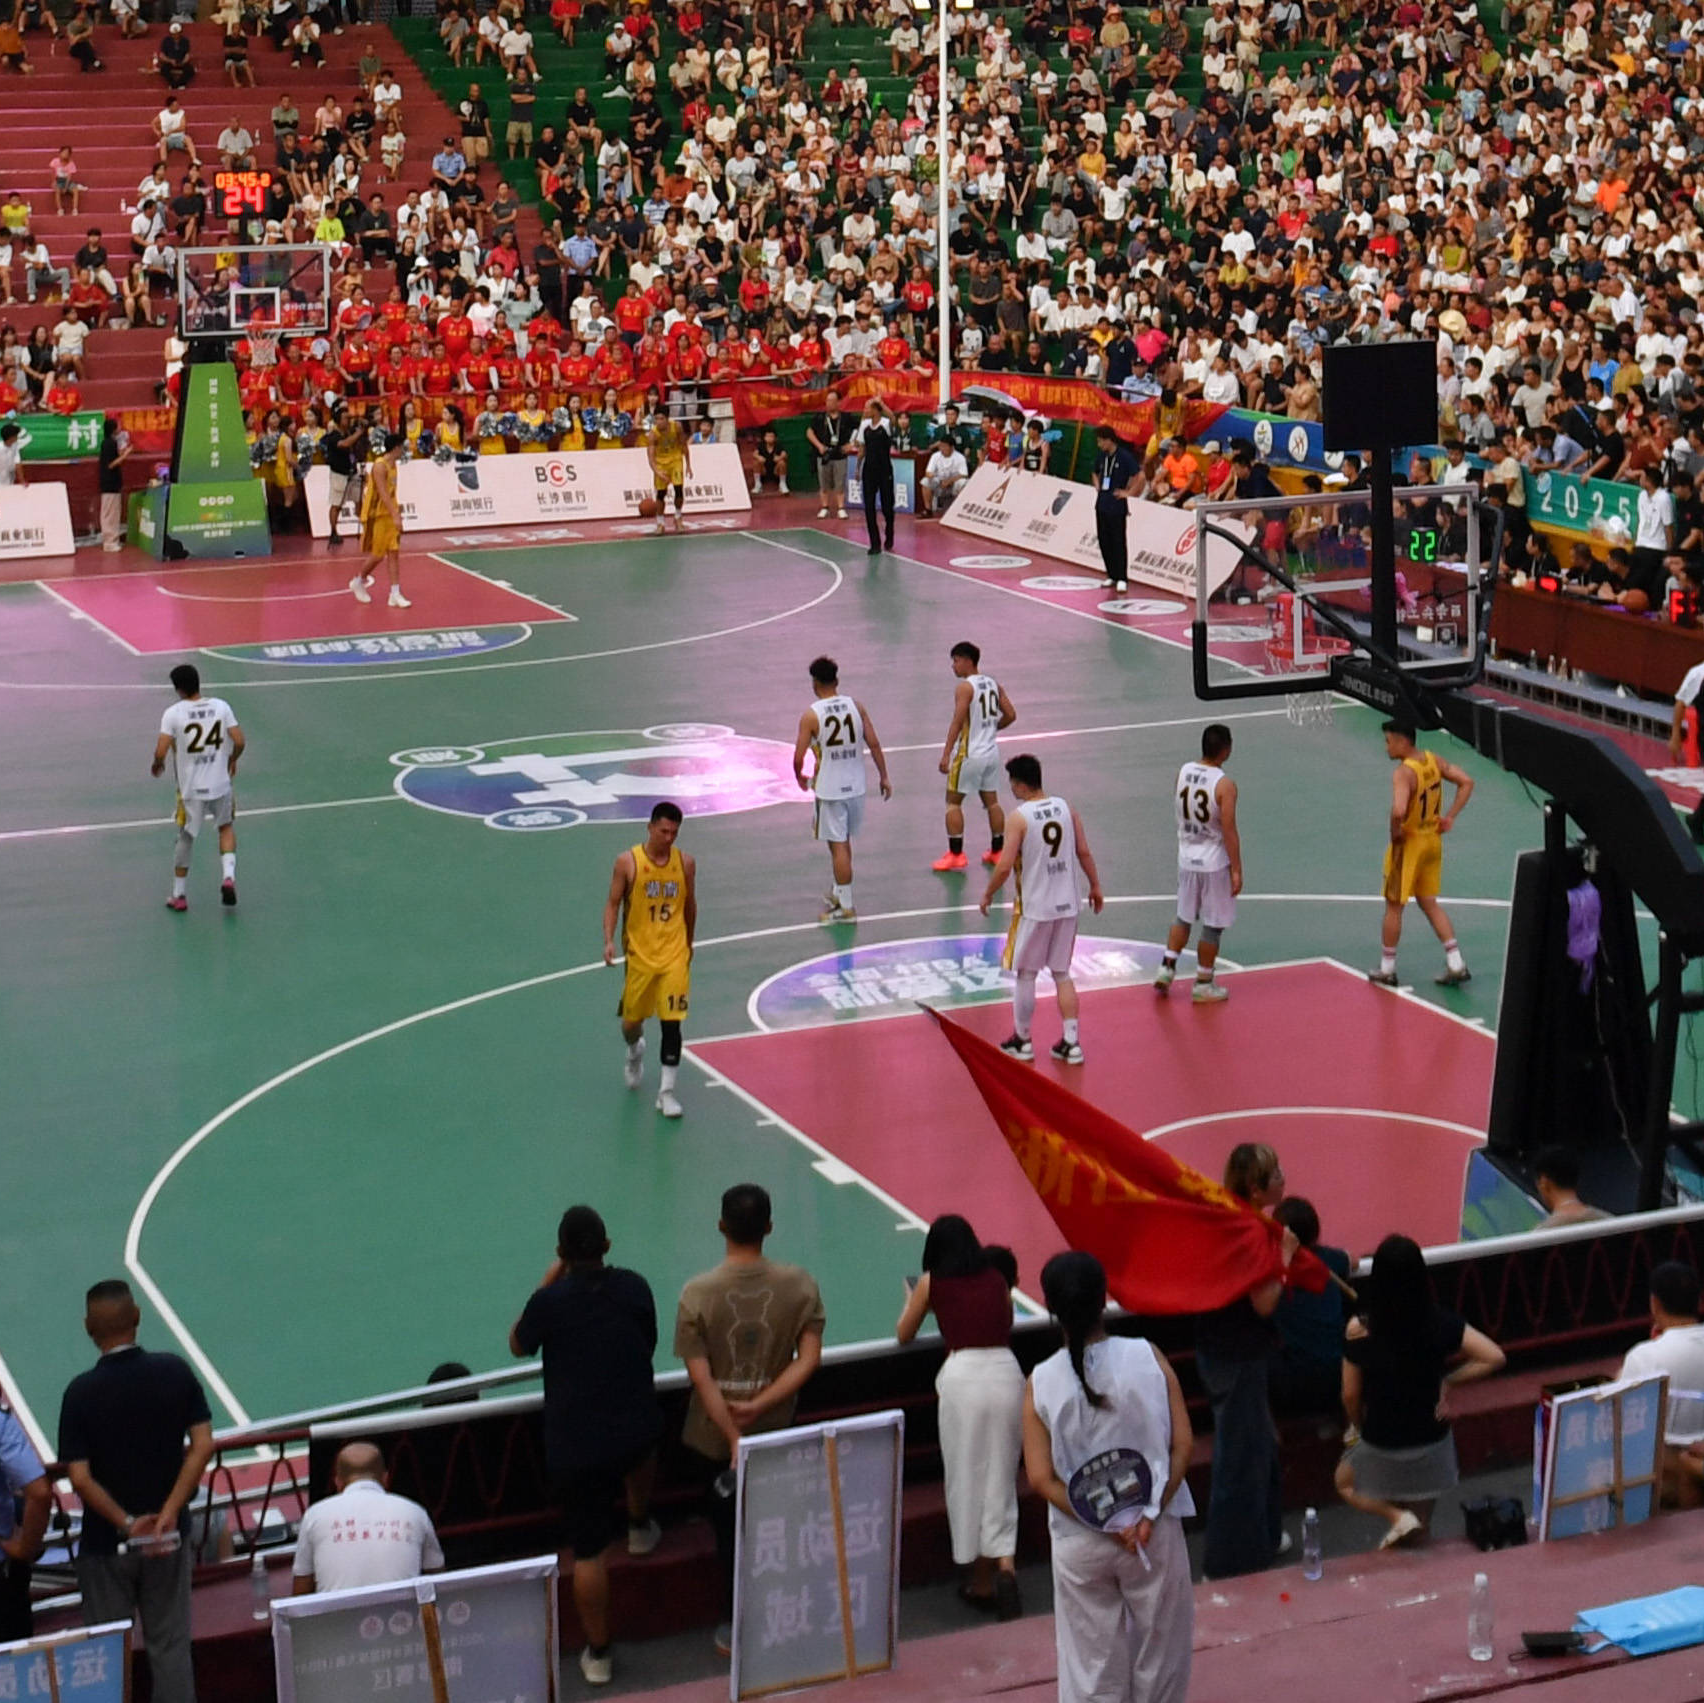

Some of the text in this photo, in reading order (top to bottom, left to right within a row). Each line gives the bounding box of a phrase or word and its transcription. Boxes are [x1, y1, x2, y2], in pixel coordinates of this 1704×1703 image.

[223, 186, 264, 215] 24
[535, 464, 578, 484] BCS
[1540, 485, 1630, 527] 2025
[1409, 530, 1437, 562] 22
[978, 689, 999, 720] 10
[183, 719, 225, 754] 24
[824, 713, 857, 747] 21
[1179, 785, 1210, 824] 13
[1041, 820, 1063, 858] 9
[649, 903, 672, 923] 15
[667, 994, 688, 1012] 15
